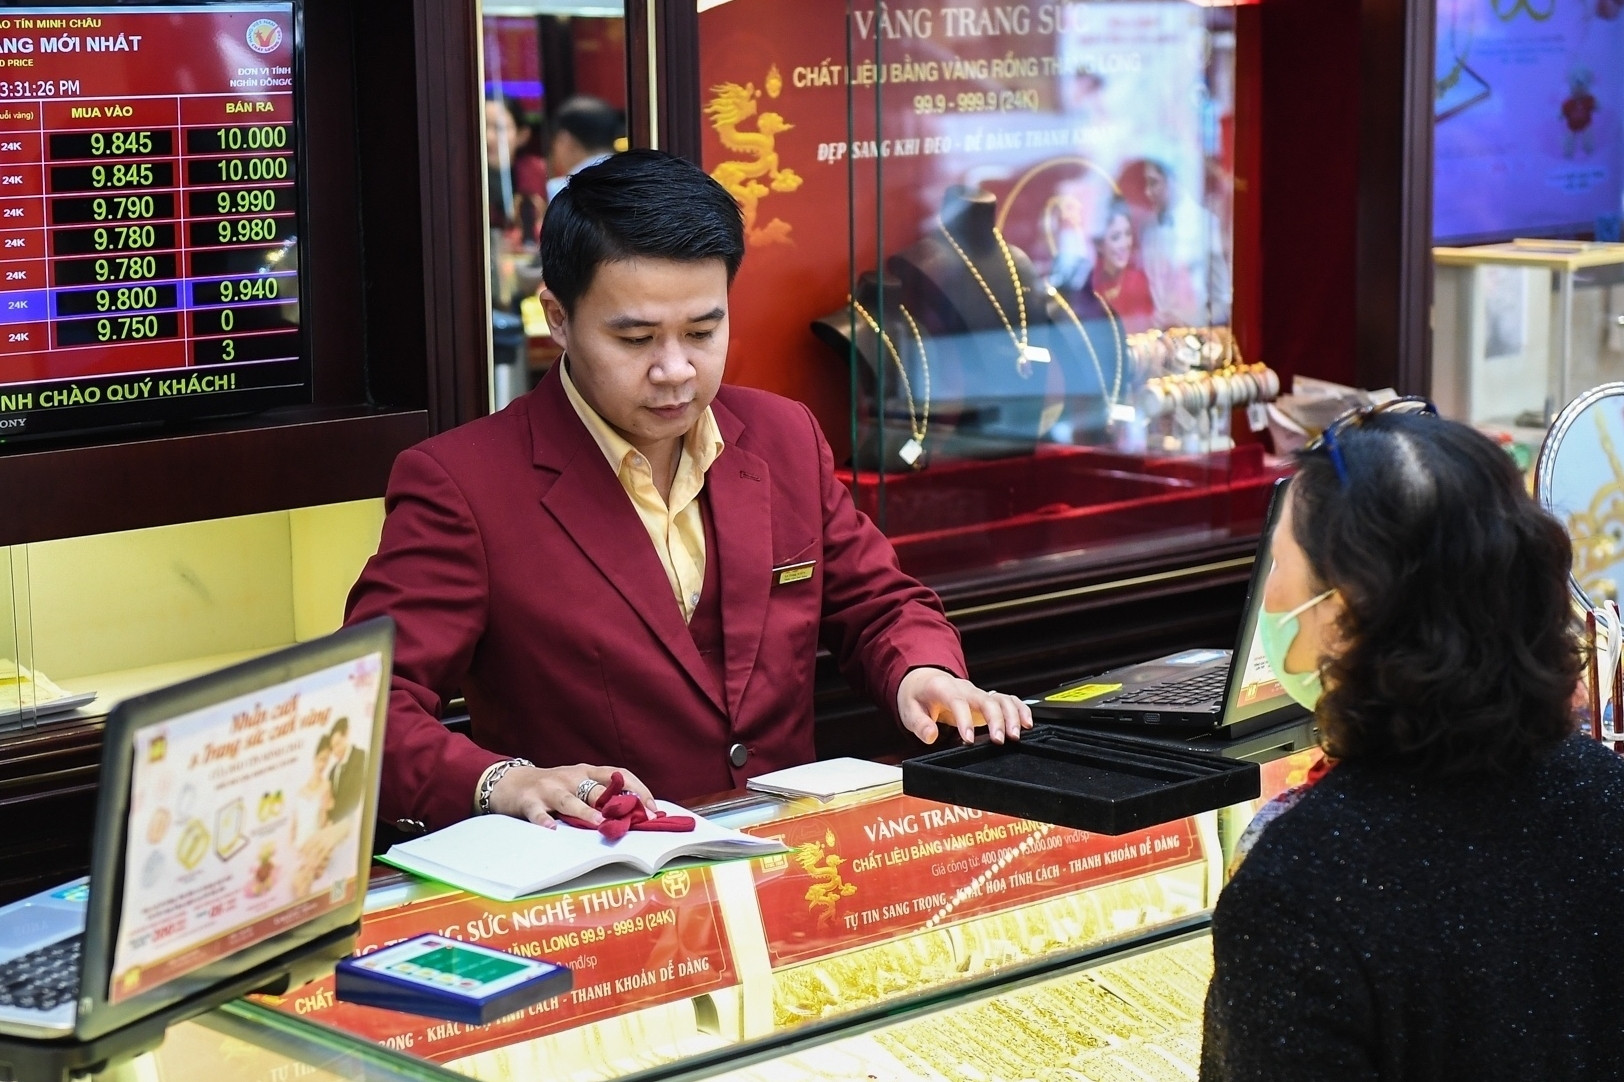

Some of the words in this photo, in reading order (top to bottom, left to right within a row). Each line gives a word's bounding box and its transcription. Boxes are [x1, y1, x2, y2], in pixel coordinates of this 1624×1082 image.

[14, 17, 33, 29] TÍN
[36, 19, 66, 28] MINH
[69, 17, 102, 28] CHÂU
[855, 1, 933, 40] VÀNG
[940, 6, 1031, 38] TRANG
[40, 33, 80, 53] MỚI
[86, 33, 142, 52] NHẤT
[7, 59, 34, 67] PRICE
[271, 66, 291, 75] TÍNH
[792, 57, 842, 88] CHẤT
[890, 54, 938, 83] BẰNG
[941, 56, 989, 80] VÀNG
[59, 80, 80, 95] PM
[71, 107, 101, 118] MUA
[105, 105, 133, 117] VÀO
[226, 101, 252, 113] BÁN
[255, 102, 274, 112] RA
[913, 94, 946, 115] 99.9
[957, 92, 998, 113] 999.9
[1000, 89, 1040, 113] (24K)
[1, 142, 22, 151] 24K
[90, 132, 152, 155] 9.845
[217, 126, 287, 149] 10.000
[893, 138, 920, 156] KHI
[2, 176, 23, 184] 24K
[92, 164, 153, 187] 9.845
[218, 157, 288, 181] 10.000
[3, 208, 24, 217] 24K
[93, 196, 154, 220] 9.790
[217, 189, 276, 214] 9.990
[94, 226, 155, 250] 9.780
[218, 218, 276, 242] 9.980
[4, 238, 26, 247] 24K
[5, 271, 27, 280] 24K
[95, 256, 156, 281] 9.780
[96, 286, 157, 311] 9.800
[220, 278, 278, 302] 9.940
[8, 300, 28, 309] 24K
[97, 316, 158, 341] 9.750
[220, 309, 234, 331] 0
[8, 333, 29, 342] 24K
[222, 339, 235, 361] 3
[39, 385, 100, 407] CHÀO
[106, 378, 152, 401] QUÝ
[158, 373, 236, 396] KHÁCH!
[863, 816, 919, 842] VÀNG
[852, 849, 882, 873] CHẤT
[884, 846, 910, 866] LIỆU
[911, 839, 943, 860] BẰNG
[943, 833, 974, 852] VÀNG
[932, 862, 946, 876] Giá
[947, 857, 968, 873] công
[844, 912, 859, 930] TỰ
[861, 908, 880, 924] TIN
[883, 901, 910, 919] SANG
[912, 892, 946, 912] TRỌNG
[986, 878, 1007, 893] HOẠ
[1009, 871, 1033, 888] TÍNH
[1035, 864, 1060, 881] CÁCH
[1069, 853, 1102, 873] THANH
[1104, 843, 1137, 865] KHOẢN
[1154, 835, 1180, 853] DÀNG
[467, 911, 509, 941] SỨC
[513, 893, 577, 931] NGHỆ
[542, 932, 579, 954] LONG
[580, 925, 605, 944] 99.9
[613, 916, 644, 936] 999.9
[645, 908, 676, 932] (24K)
[571, 982, 612, 1005] THANH
[615, 968, 657, 994] KHOẢN
[678, 956, 710, 977] DÀNG
[295, 986, 334, 1015] CHẤT
